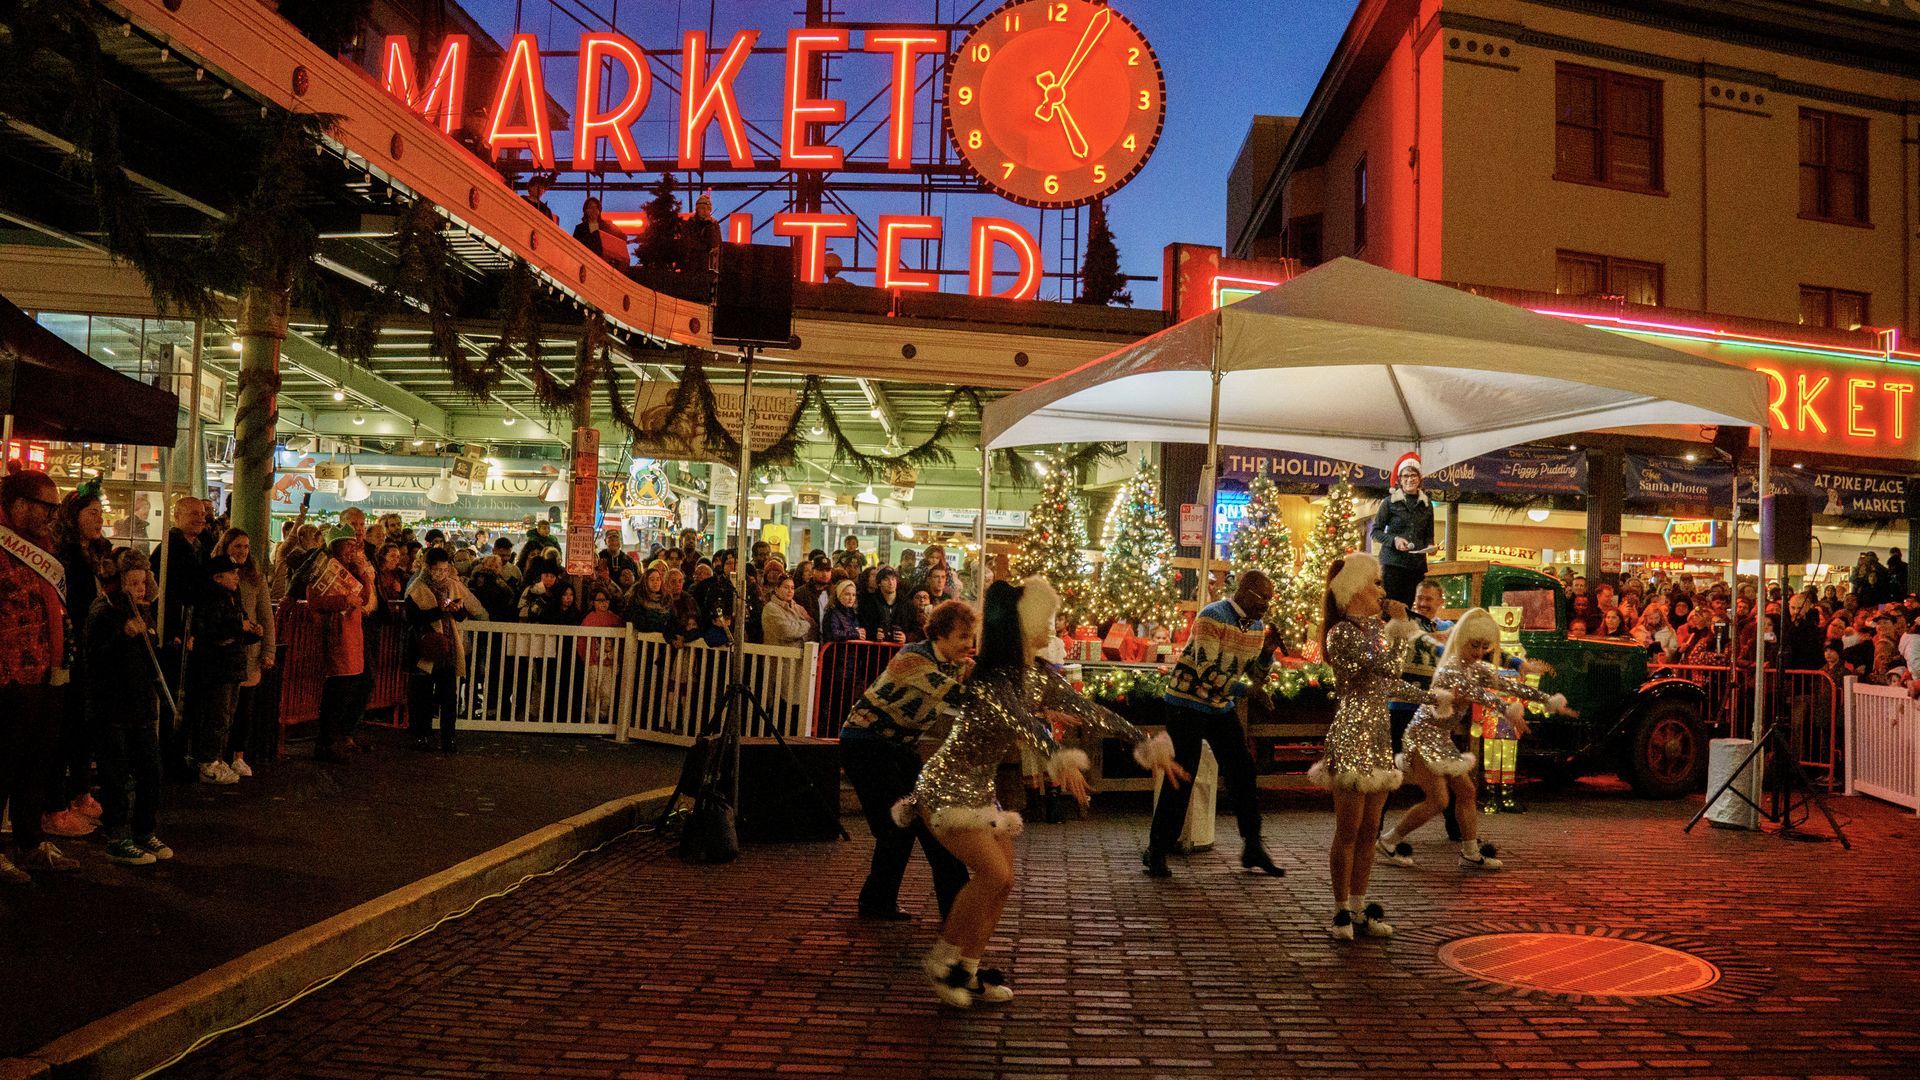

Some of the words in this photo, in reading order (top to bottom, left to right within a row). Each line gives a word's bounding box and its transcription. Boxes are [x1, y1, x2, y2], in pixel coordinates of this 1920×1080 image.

[1048, 3, 1068, 22] 12
[1005, 15, 1020, 32] 11
[972, 44, 990, 63] 10
[1127, 48, 1140, 66] 2
[381, 28, 946, 171] MARKET
[958, 86, 973, 105] 9
[1137, 90, 1151, 110] 3
[968, 129, 983, 149] 8
[1122, 134, 1136, 152] 4
[1002, 162, 1016, 179] 7
[1093, 165, 1107, 183] 5
[1044, 175, 1059, 194] 6
[1272, 458, 1365, 479] HOLIDAYS
[1511, 463, 1539, 479] Figgy
[1540, 462, 1577, 478] Pudding
[1639, 479, 1669, 492] Santa
[1672, 482, 1708, 495] Photos
[1814, 474, 1829, 488] AT
[1833, 475, 1863, 490] PIKE
[1864, 478, 1905, 494] PLACE
[1852, 497, 1906, 513] MARKET
[1669, 533, 1711, 546] GROCERY
[4, 536, 52, 574] MAYOR
[1479, 545, 1537, 560] BAKERY
